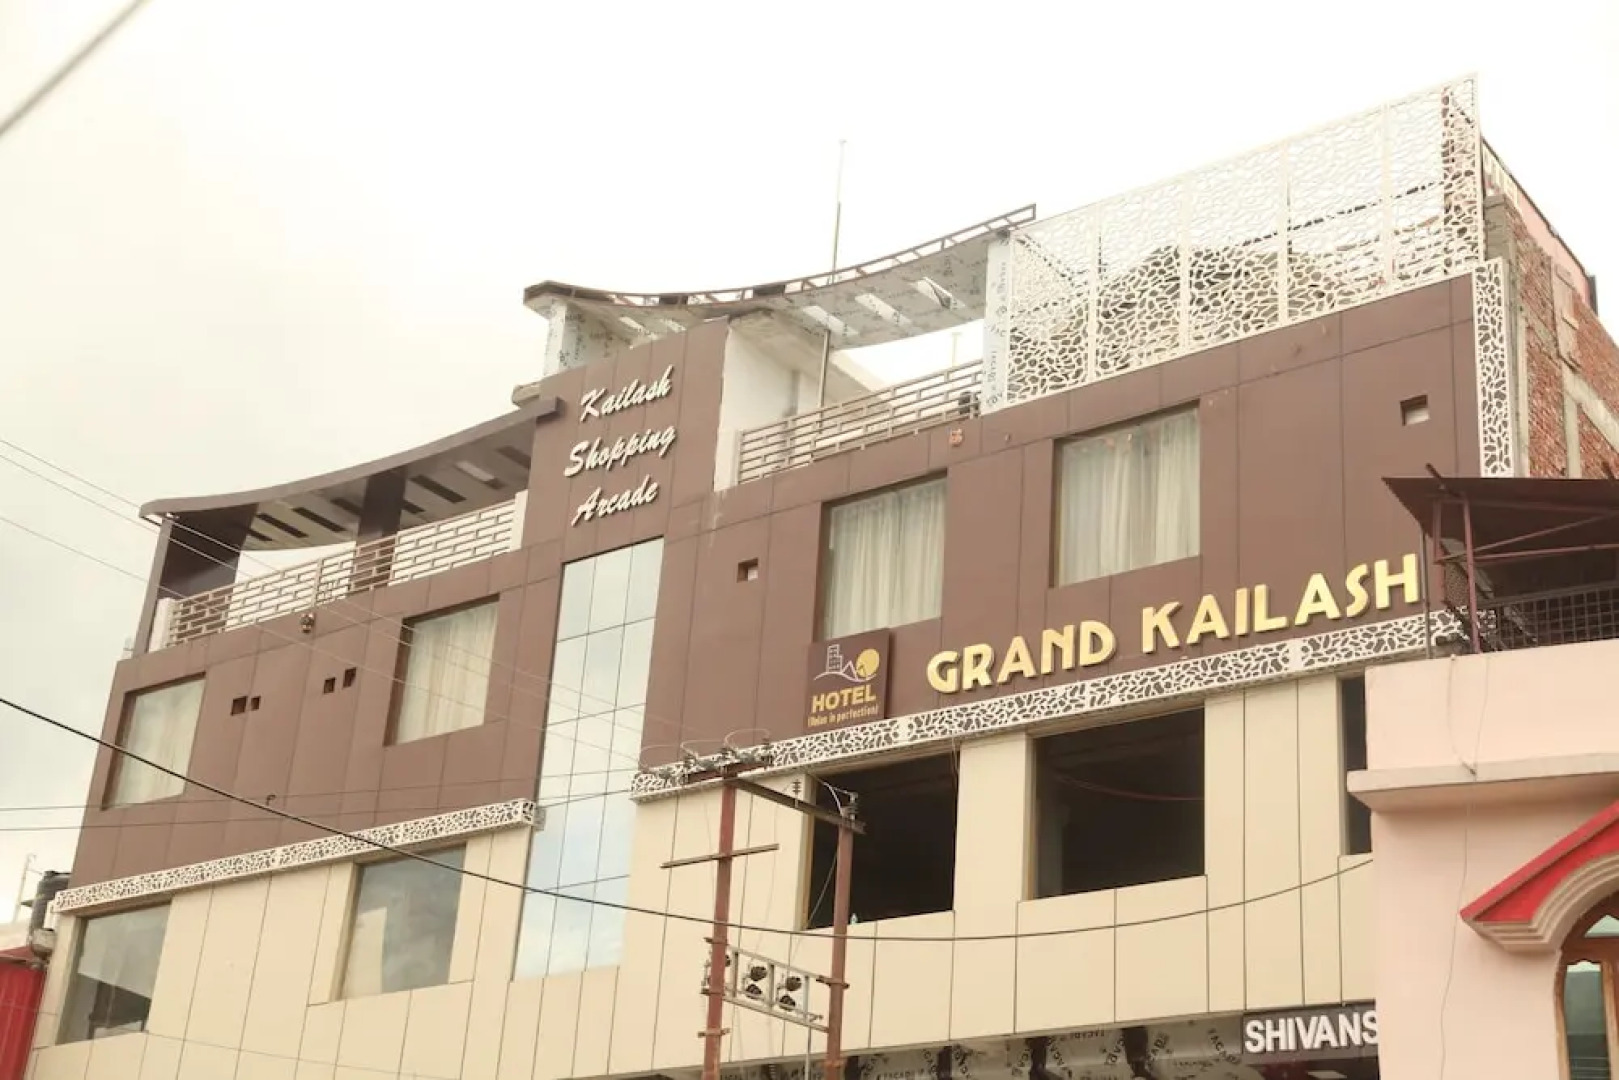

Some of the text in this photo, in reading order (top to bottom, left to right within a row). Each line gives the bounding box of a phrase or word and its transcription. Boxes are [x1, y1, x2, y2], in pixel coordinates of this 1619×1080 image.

[580, 364, 674, 423] Kailash
[564, 425, 677, 478] Shopping
[571, 473, 660, 528] Arcade
[926, 553, 1422, 695] GRAND KAILASH
[812, 684, 877, 714] HOTEL
